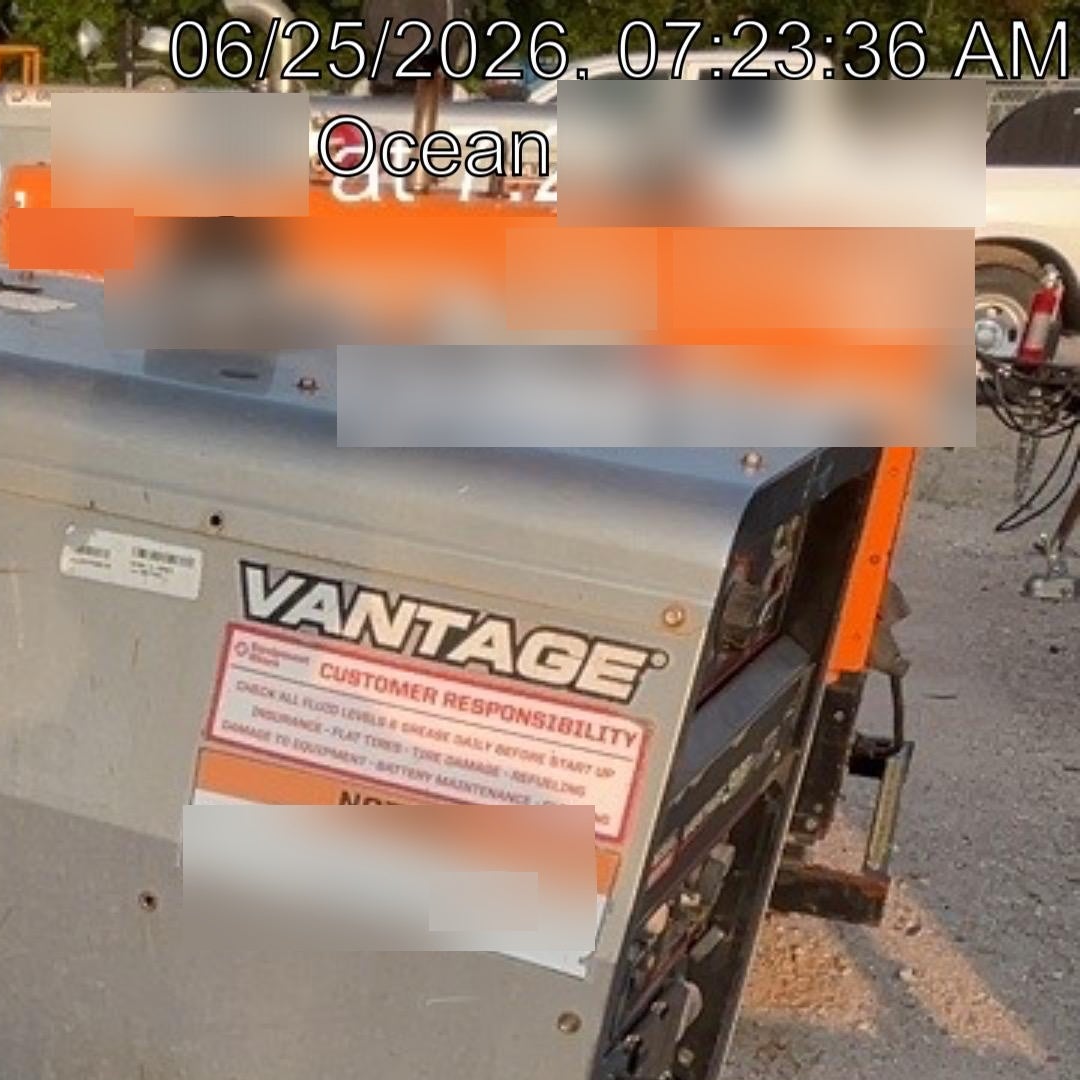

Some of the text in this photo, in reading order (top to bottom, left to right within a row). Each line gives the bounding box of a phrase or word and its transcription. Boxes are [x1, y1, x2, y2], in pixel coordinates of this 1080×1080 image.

[240, 560, 651, 705] VANTAGE
[235, 680, 275, 698] CHECK
[278, 690, 299, 706] ALL
[302, 697, 341, 715] FLUID
[341, 706, 387, 727] LEVELS
[400, 721, 451, 745] GREASE
[453, 734, 497, 752] DAILY
[494, 742, 547, 763] BEFORE
[549, 753, 593, 774] START
[595, 767, 617, 779] UP
[251, 704, 586, 798] INSURANCE FLAT TIRES TIRE DAMAGE REFUELING
[319, 662, 638, 748] CUSTOMER RESPONSIBILITY
[221, 718, 532, 804] DAMAGE TO EQUIPMENT BATTERY MAINTENANCE
